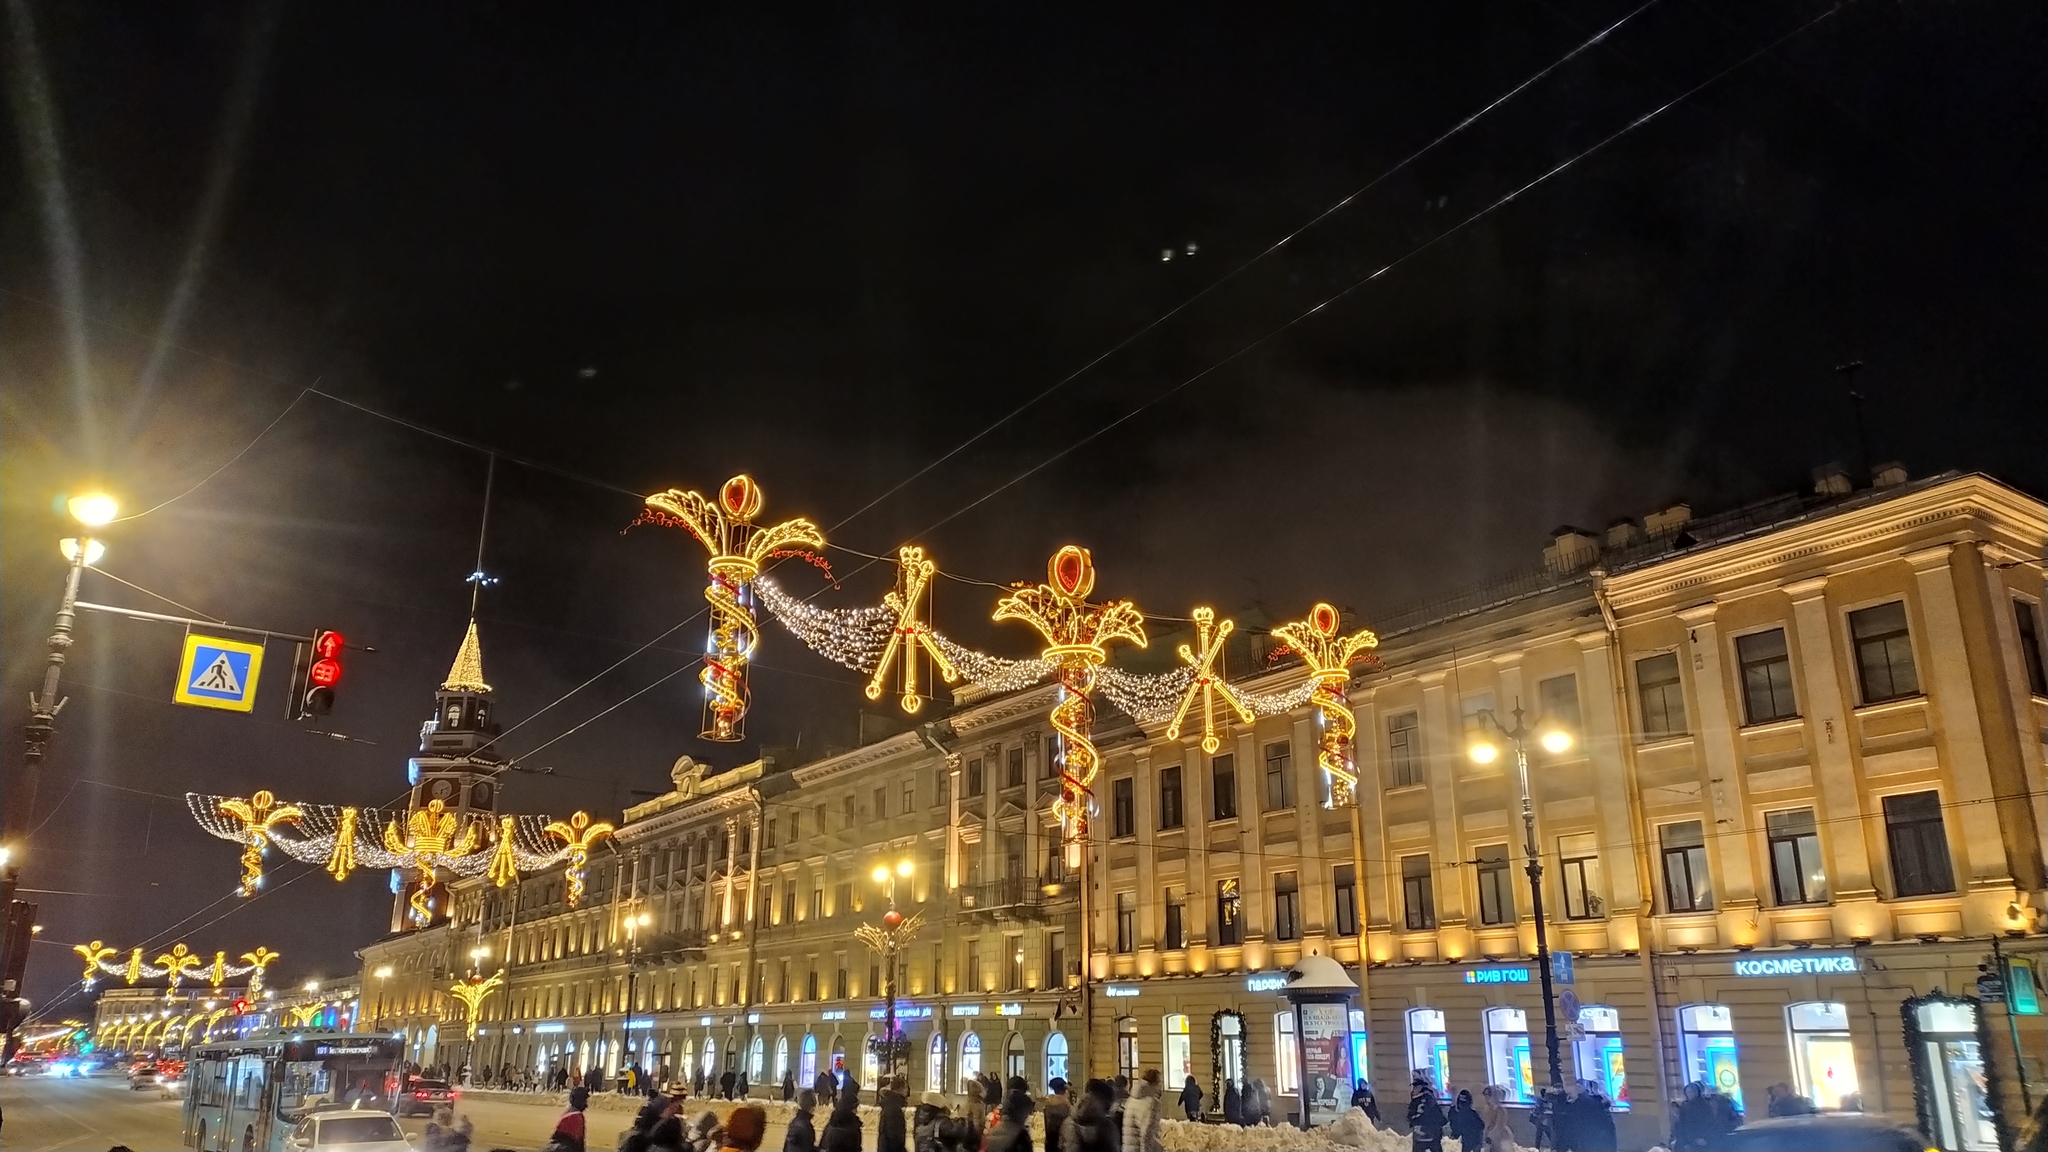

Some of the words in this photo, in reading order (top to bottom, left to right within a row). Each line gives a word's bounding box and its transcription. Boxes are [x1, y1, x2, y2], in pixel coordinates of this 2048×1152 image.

[1735, 956, 1857, 976] косметика
[1476, 970, 1501, 983] РИВ
[1501, 969, 1529, 982] ГОШ
